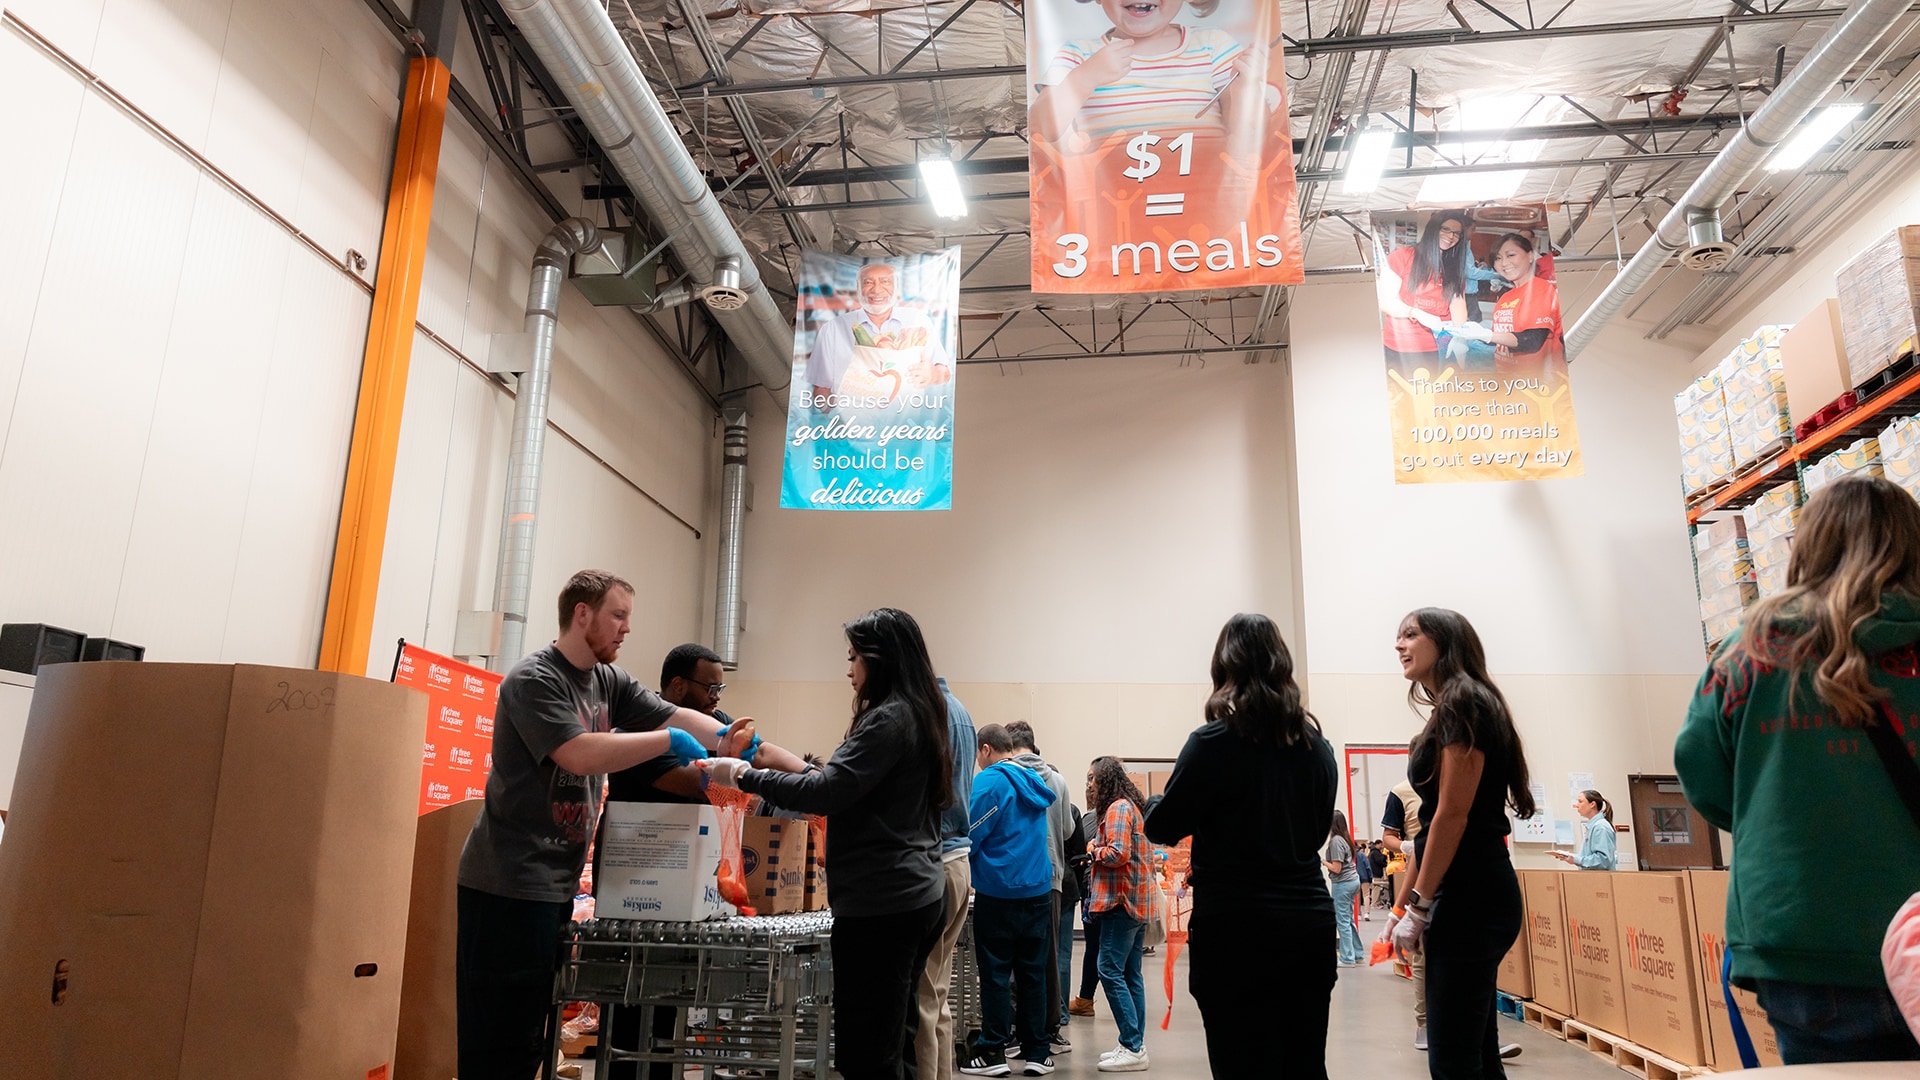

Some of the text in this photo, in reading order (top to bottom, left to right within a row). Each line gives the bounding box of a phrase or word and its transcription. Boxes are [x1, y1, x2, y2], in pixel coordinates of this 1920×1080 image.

[1122, 131, 1194, 183] $1
[1145, 192, 1185, 216] =
[1052, 221, 1283, 278] 3 meals
[1408, 376, 1545, 396] Thanks to you,
[799, 390, 947, 414] Because your
[1433, 399, 1528, 418] more than
[792, 414, 948, 447] golden years
[1410, 421, 1559, 444] 100,000 meals
[812, 448, 925, 470] should be
[1401, 446, 1573, 472] go out every day
[810, 477, 925, 506] delicious
[457, 756, 474, 766] square
[458, 747, 471, 758] three
[432, 791, 452, 801] square
[434, 782, 449, 792] three
[623, 900, 662, 912] Sunkist
[1580, 920, 1601, 942] three
[1638, 927, 1665, 954] three
[1582, 943, 1609, 965] square
[1641, 953, 1675, 981] square
